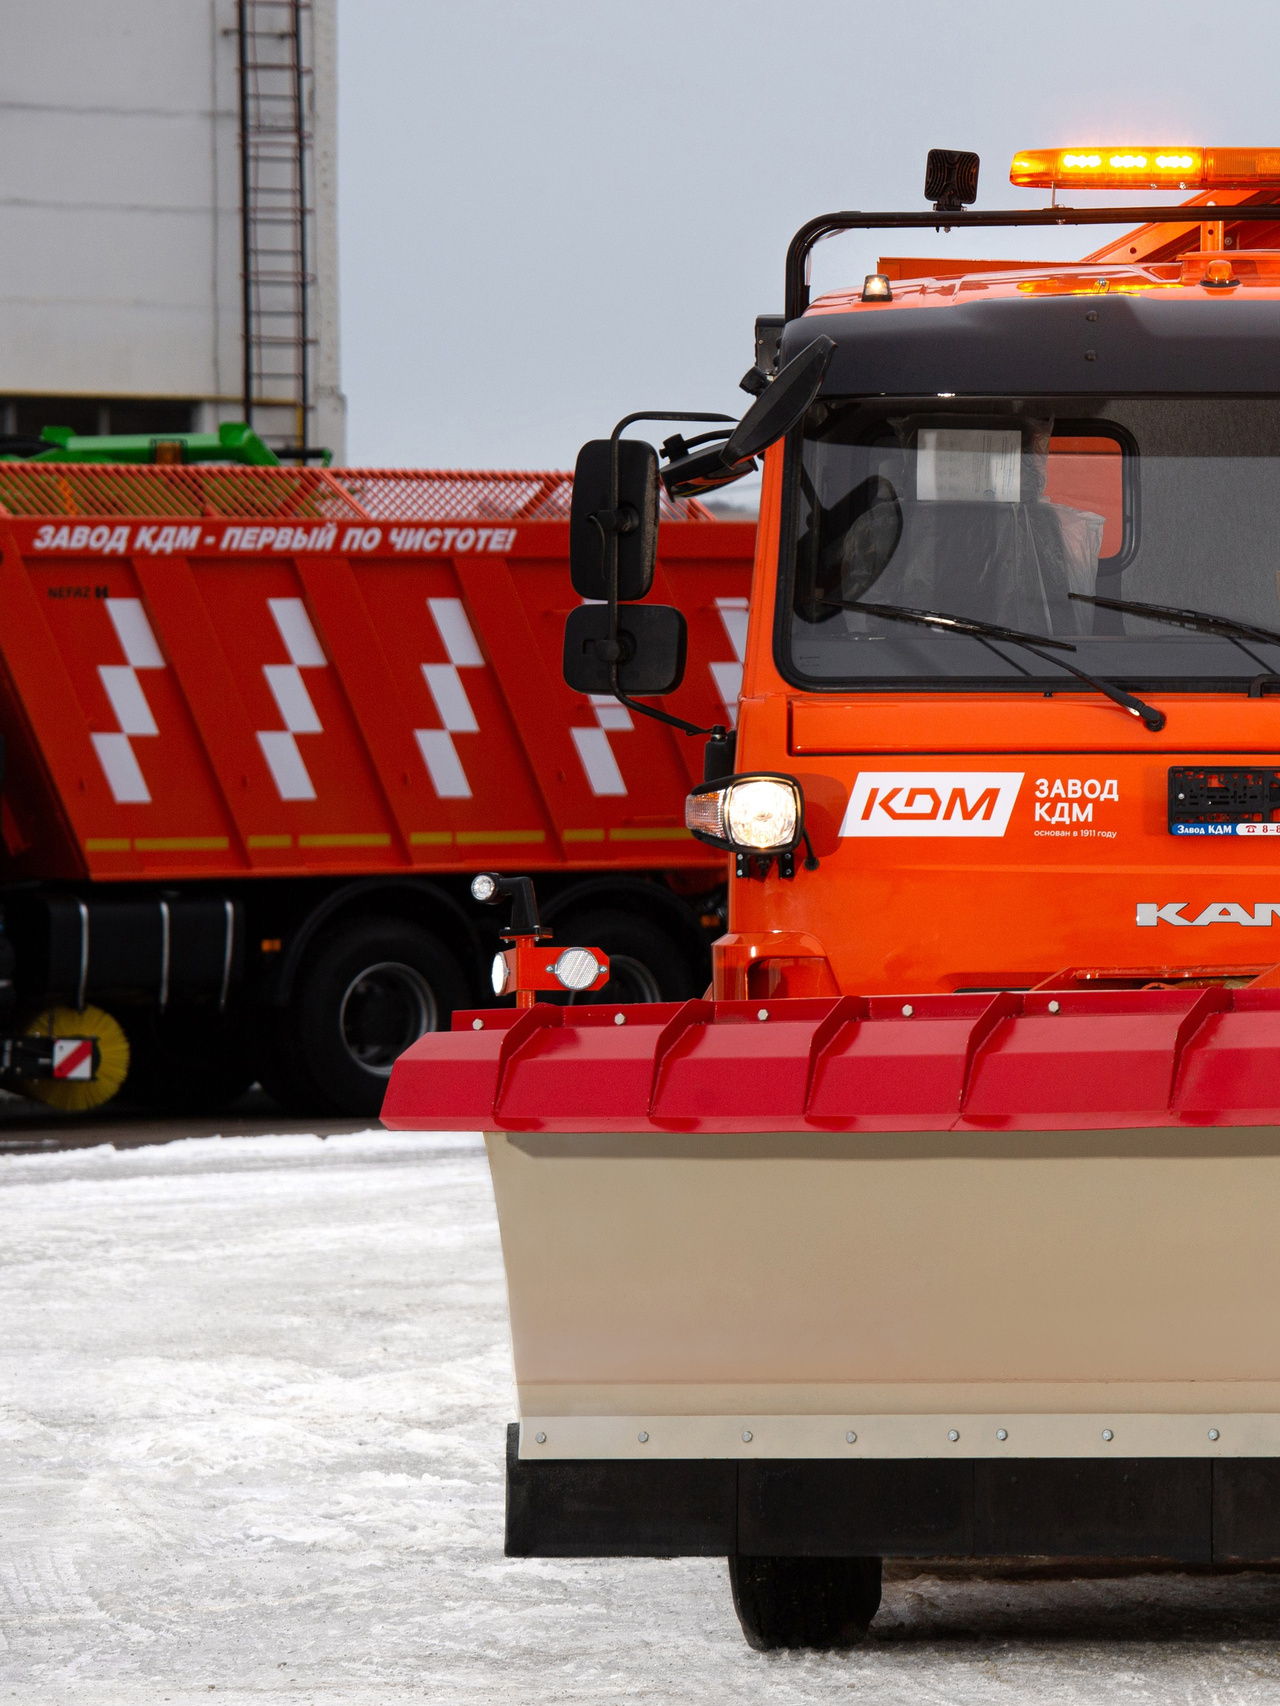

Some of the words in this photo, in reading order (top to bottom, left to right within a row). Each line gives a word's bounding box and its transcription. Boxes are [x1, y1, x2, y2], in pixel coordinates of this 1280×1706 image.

[33, 525, 131, 554] ЗАВОД
[134, 526, 202, 554] КДМ
[219, 522, 338, 551] ПЕРВЫЙ
[341, 527, 382, 551] ПО
[389, 528, 517, 551] ЧИСТОТЕ!
[1034, 778, 1119, 801] ЗАВОД
[861, 788, 1001, 820] KDM
[1034, 802, 1093, 825] КДМ
[1080, 829, 1096, 837] 1911
[1097, 830, 1117, 838] году
[1208, 825, 1232, 834] КДМ
